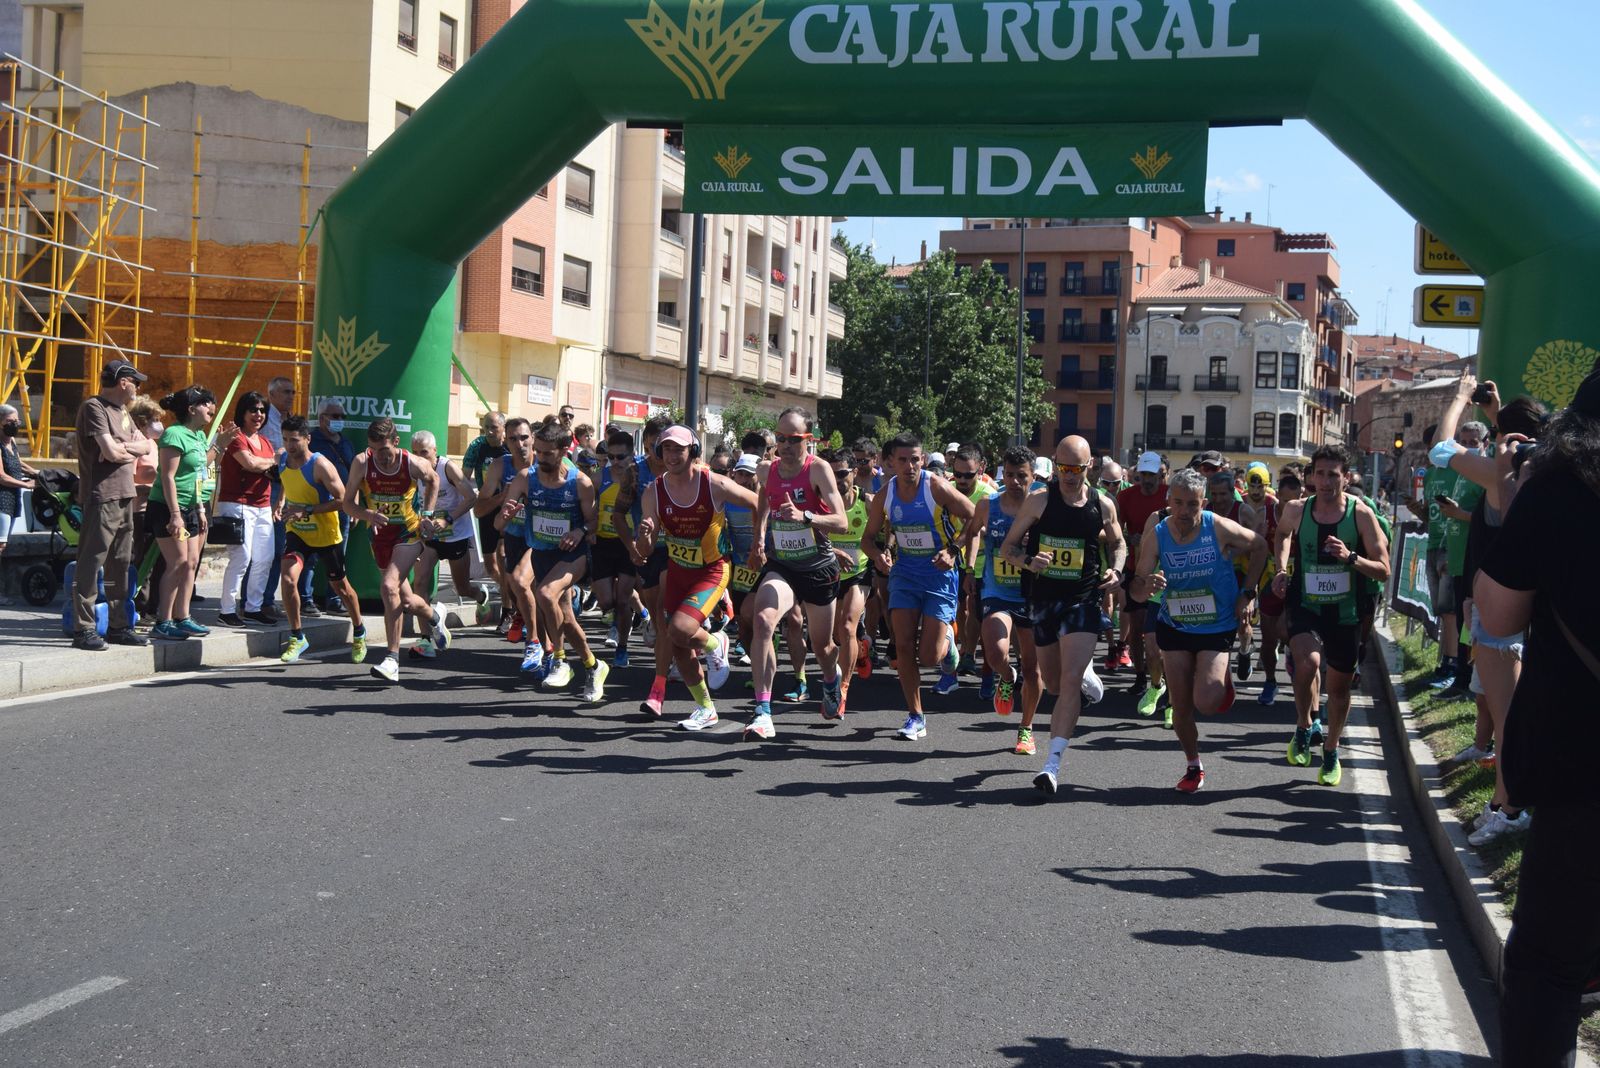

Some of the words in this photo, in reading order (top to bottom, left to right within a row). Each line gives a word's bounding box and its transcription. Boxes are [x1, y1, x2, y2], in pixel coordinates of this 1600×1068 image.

[788, 0, 973, 68] CAJA
[981, 0, 1260, 62] RURAL
[778, 146, 1099, 196] SALIDA
[701, 181, 726, 192] CAJA
[727, 181, 764, 193] RURAL
[1115, 182, 1144, 194] CAJA
[1144, 182, 1185, 194] RURAL
[545, 525, 564, 536] NIETO
[780, 537, 807, 549] GARGAR
[670, 543, 698, 562] 227
[1317, 580, 1337, 592] PEÓN
[1180, 603, 1205, 615] MANSO
